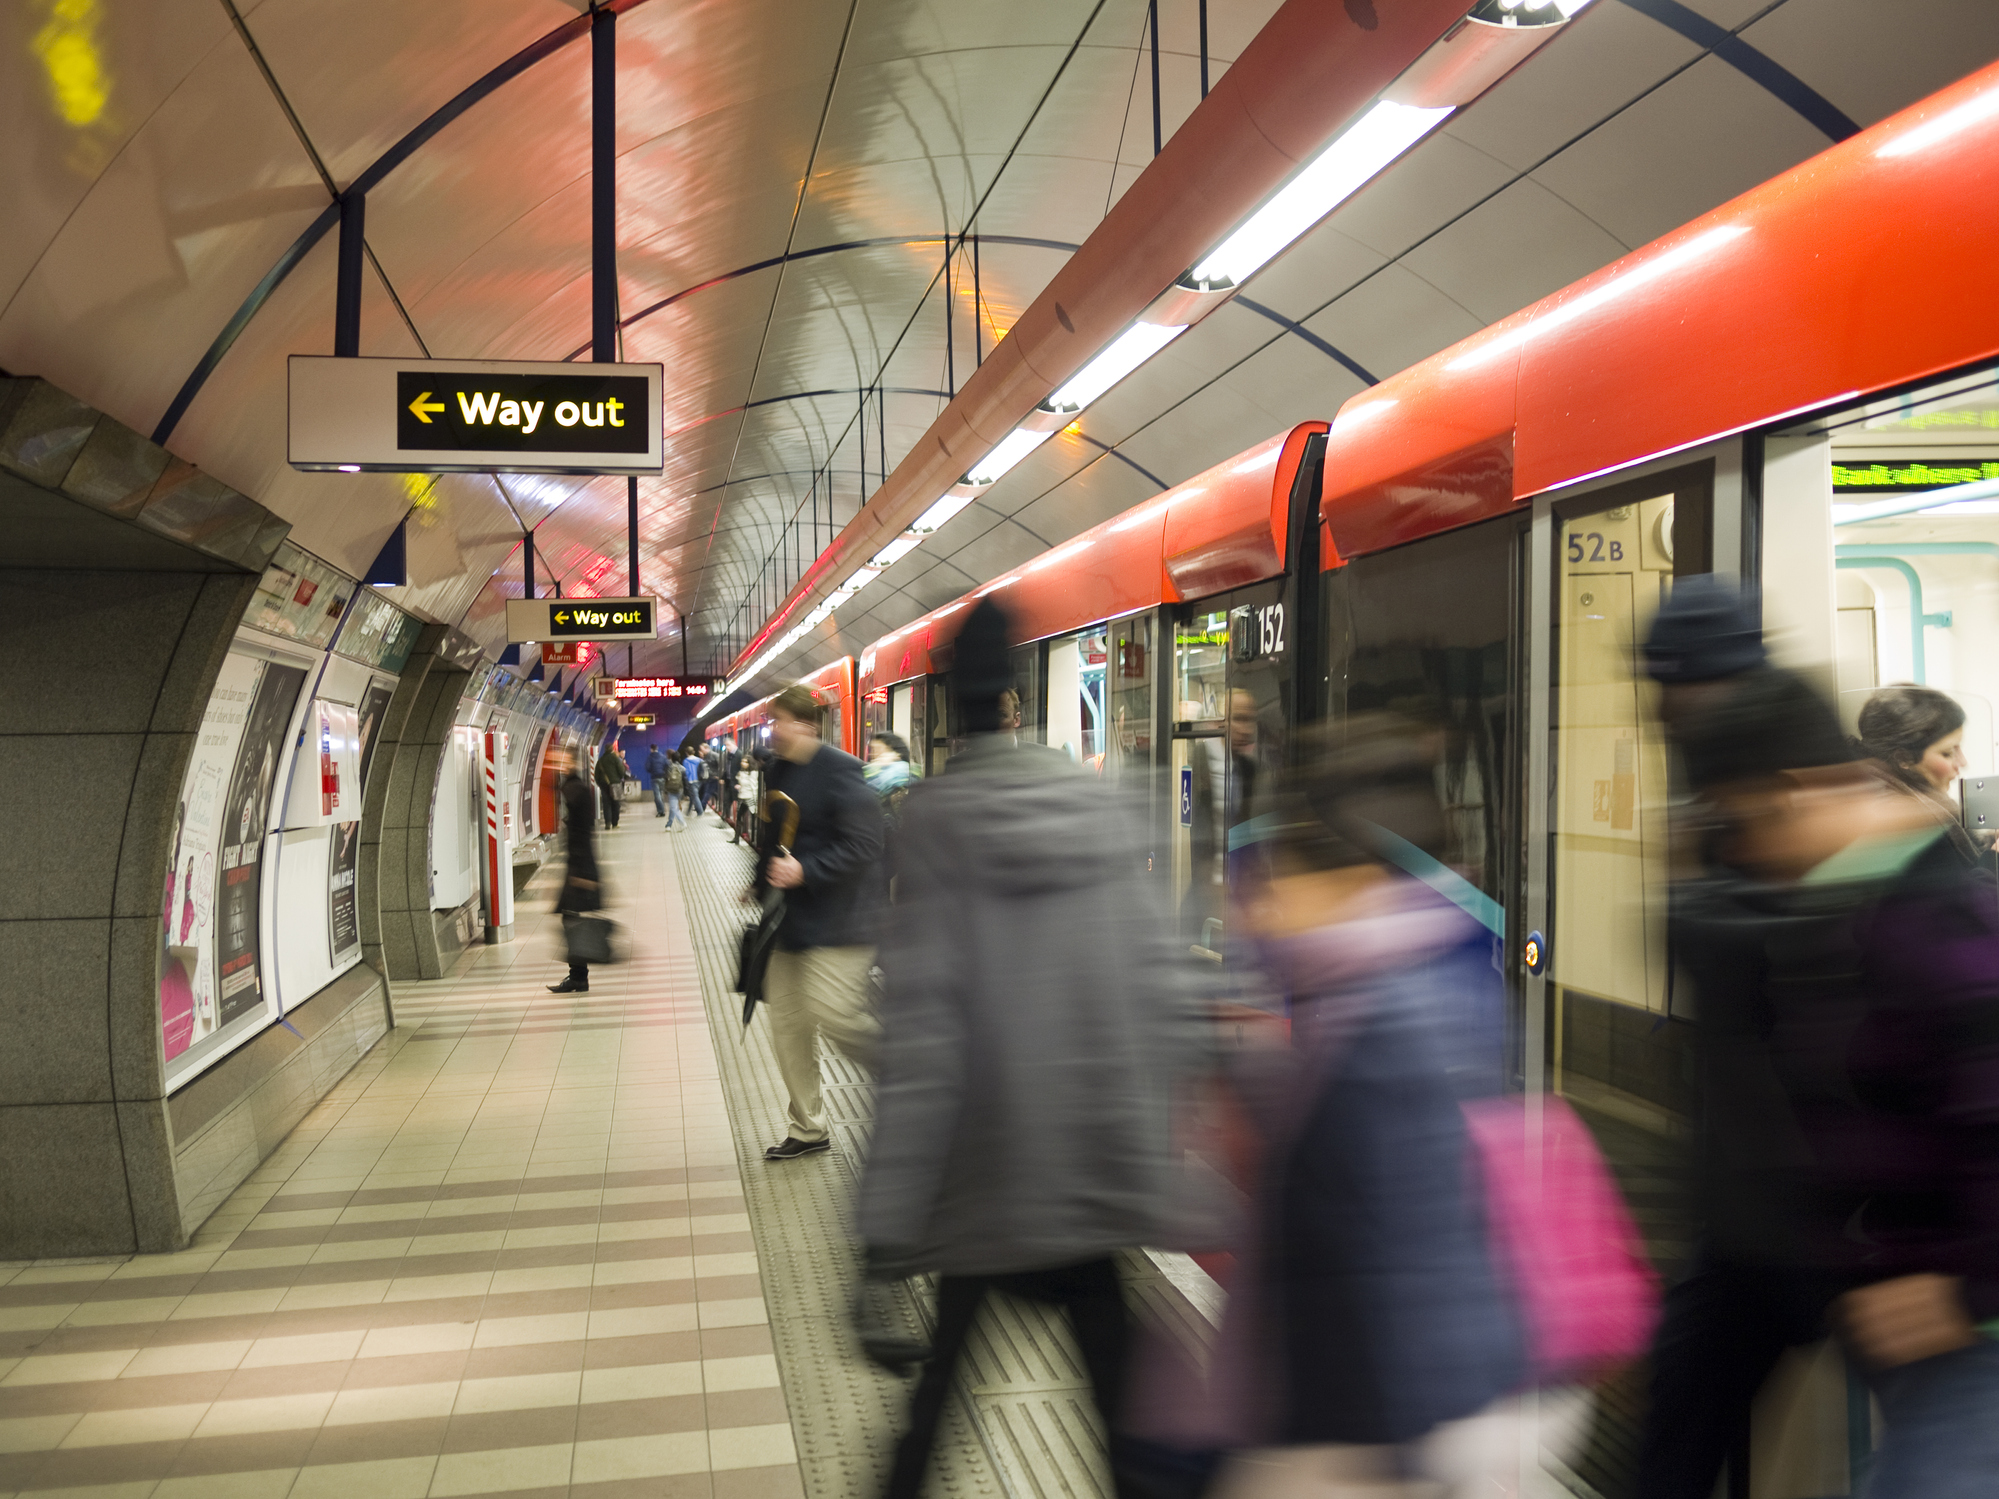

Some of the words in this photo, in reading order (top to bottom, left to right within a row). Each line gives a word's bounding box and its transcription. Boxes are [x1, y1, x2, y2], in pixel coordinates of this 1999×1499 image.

[456, 391, 545, 434] Way
[554, 396, 625, 428] out
[573, 610, 609, 627] Way
[612, 610, 642, 624] out
[1259, 602, 1284, 655] 152
[548, 653, 571, 661] Alarm
[713, 679, 725, 693] 10
